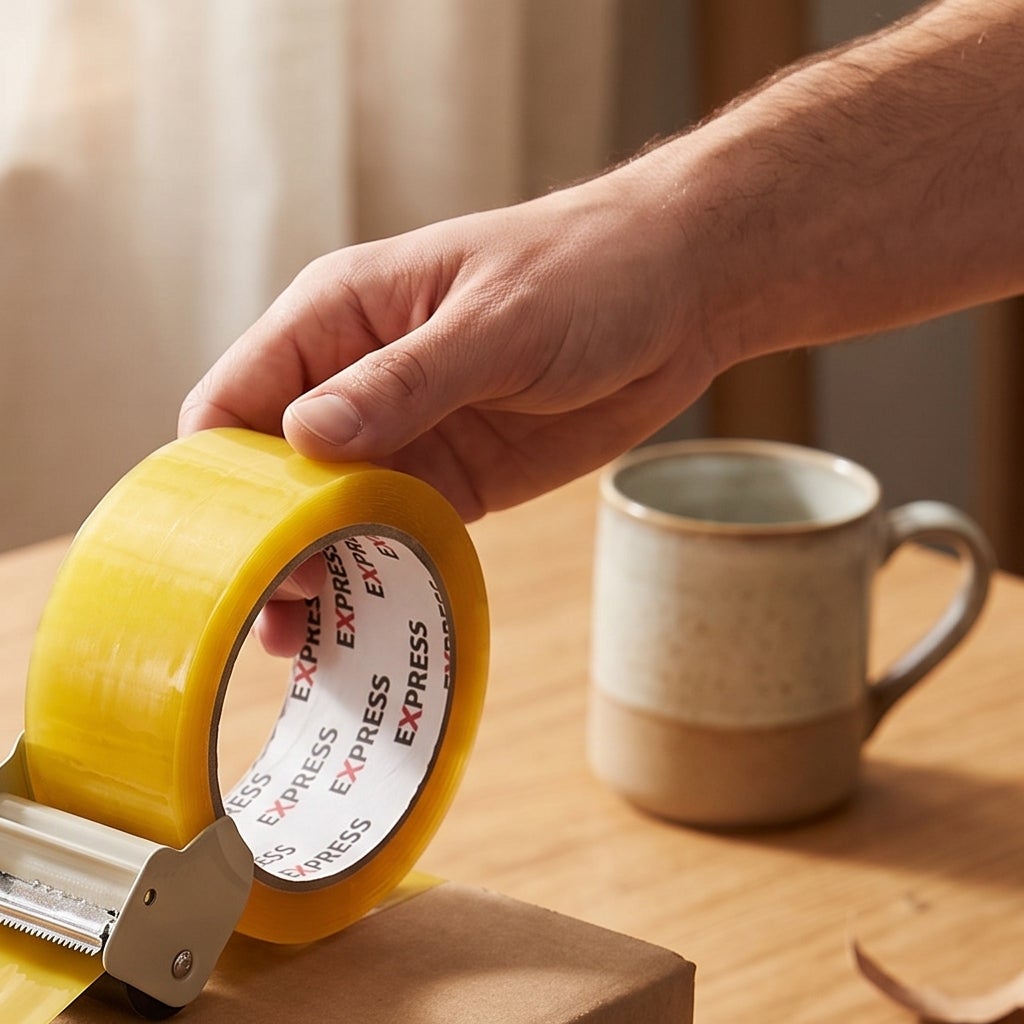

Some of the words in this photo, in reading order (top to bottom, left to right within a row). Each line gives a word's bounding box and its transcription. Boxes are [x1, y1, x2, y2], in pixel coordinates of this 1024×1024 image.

[329, 674, 391, 796] EXPRESS
[393, 619, 429, 747] EXPRESS
[256, 726, 338, 826] EXPRESS
[278, 817, 372, 878] EXPRESS
